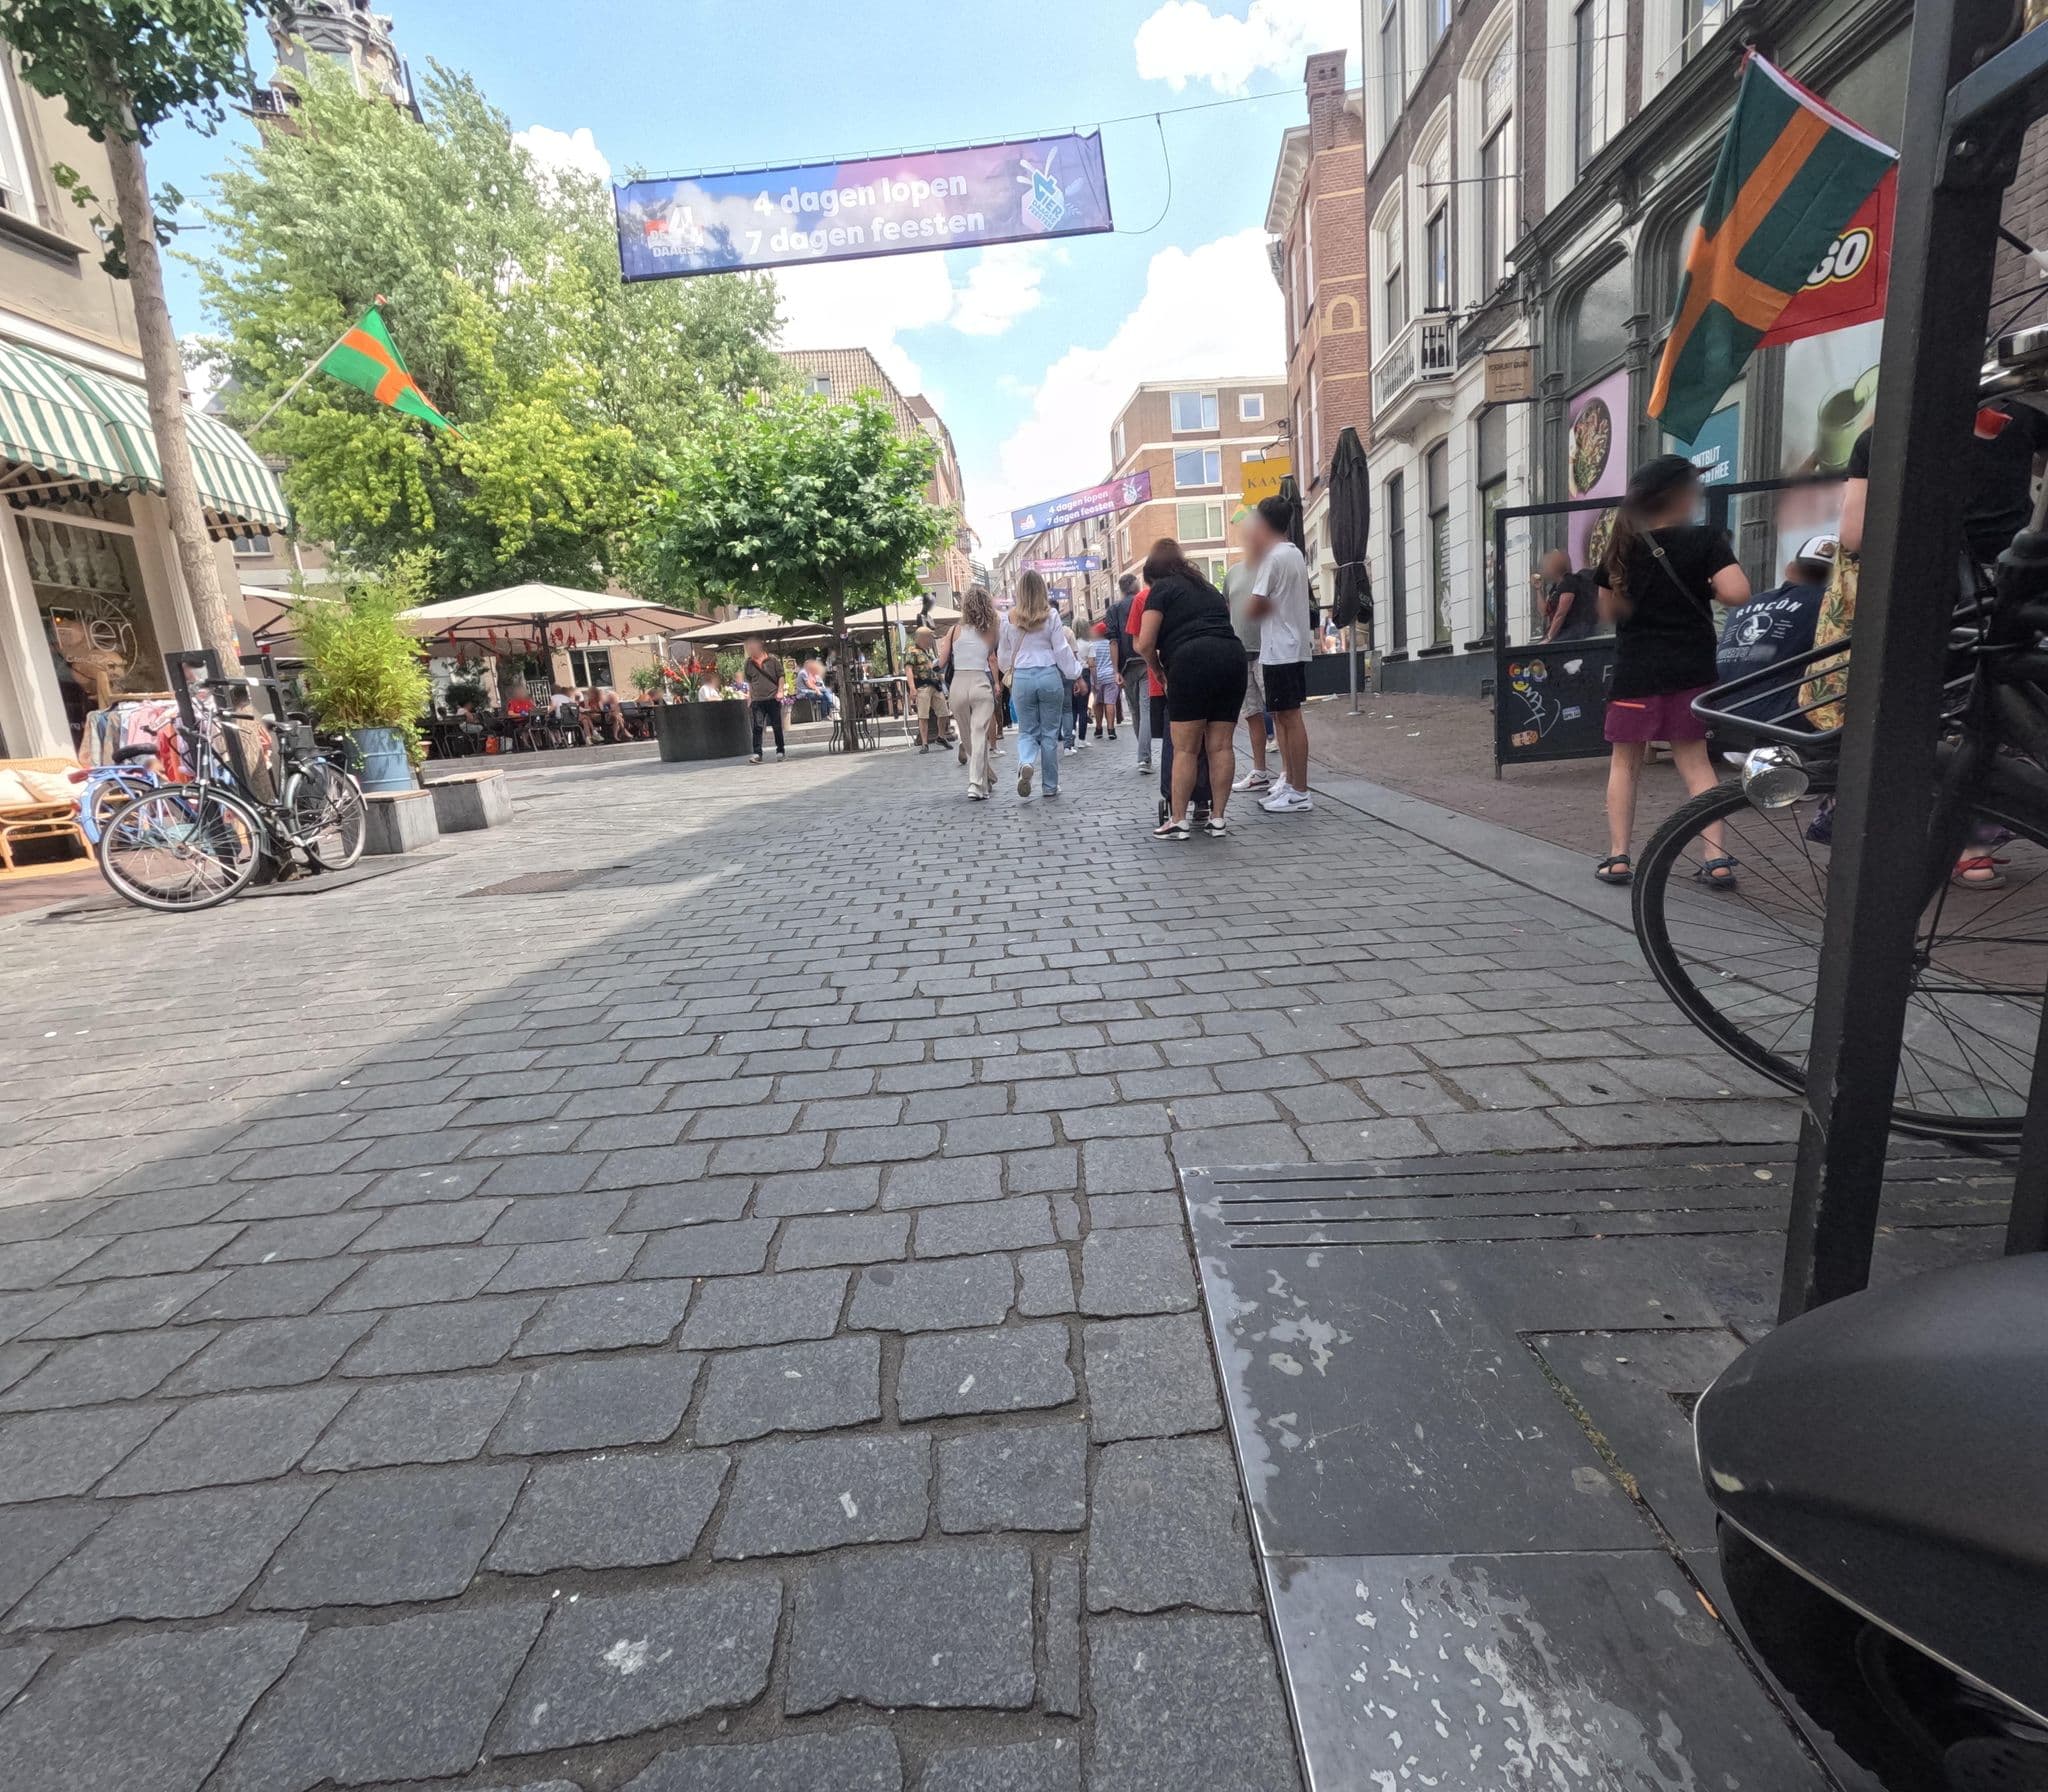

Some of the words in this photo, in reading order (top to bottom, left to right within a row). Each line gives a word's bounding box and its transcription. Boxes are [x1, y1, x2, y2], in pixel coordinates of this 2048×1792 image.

[753, 190, 774, 216] 4
[780, 185, 876, 217] dagen
[881, 175, 967, 208] lopen
[745, 230, 762, 255] 7
[770, 226, 865, 256] dagen
[870, 212, 985, 243] feesten
[1806, 231, 1870, 285] GO
[1247, 475, 1279, 489] KAA
[1046, 518, 1053, 526] 7
[1053, 510, 1080, 525] dagen
[1081, 500, 1115, 516] feesten
[1048, 505, 1055, 514] 4
[1056, 498, 1083, 514] dagen
[1083, 490, 1109, 504] lopen
